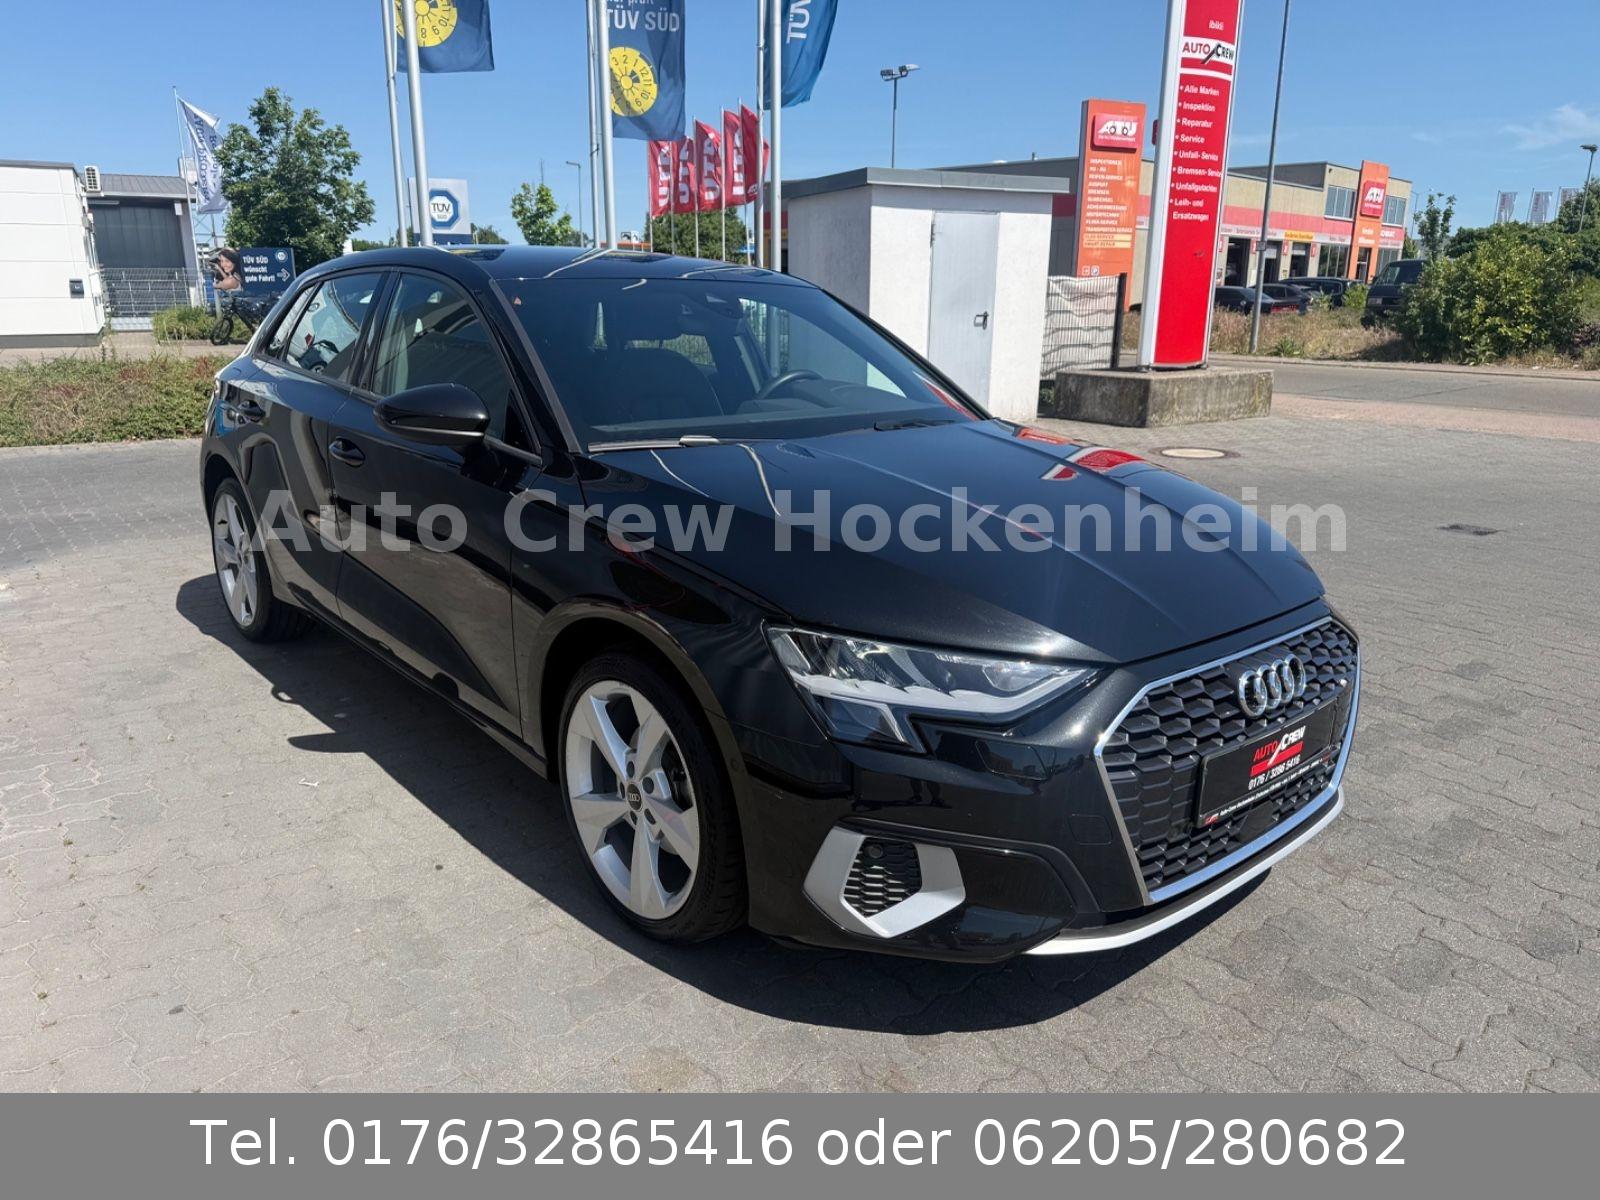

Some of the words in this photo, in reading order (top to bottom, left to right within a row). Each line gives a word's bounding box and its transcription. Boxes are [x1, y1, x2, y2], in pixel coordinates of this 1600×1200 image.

[607, 5, 640, 30] TÜV
[645, 8, 680, 32] SÜD
[420, 27, 427, 39] 8
[1182, 41, 1211, 55] AUTO
[1215, 43, 1235, 60] CREW
[612, 56, 619, 66] 3
[622, 54, 629, 64] 2
[640, 66, 649, 77] 12
[1184, 85, 1198, 94] Alle
[1199, 86, 1220, 96] Marken
[1182, 101, 1215, 112] Inspektion
[1181, 117, 1213, 128] Reparatur
[1180, 134, 1205, 144] Service
[1179, 150, 1201, 159] Unfall-
[1201, 151, 1218, 162] Service
[1177, 166, 1207, 176] Bremsen-
[1175, 182, 1217, 193] Unfallgutachten
[1172, 212, 1209, 222] Ersatzwagen
[243, 255, 255, 264] TÜV
[256, 255, 269, 264] SÜD
[244, 266, 268, 274] wünscht
[1252, 740, 1278, 762] AUTO
[1279, 725, 1306, 751] CREW
